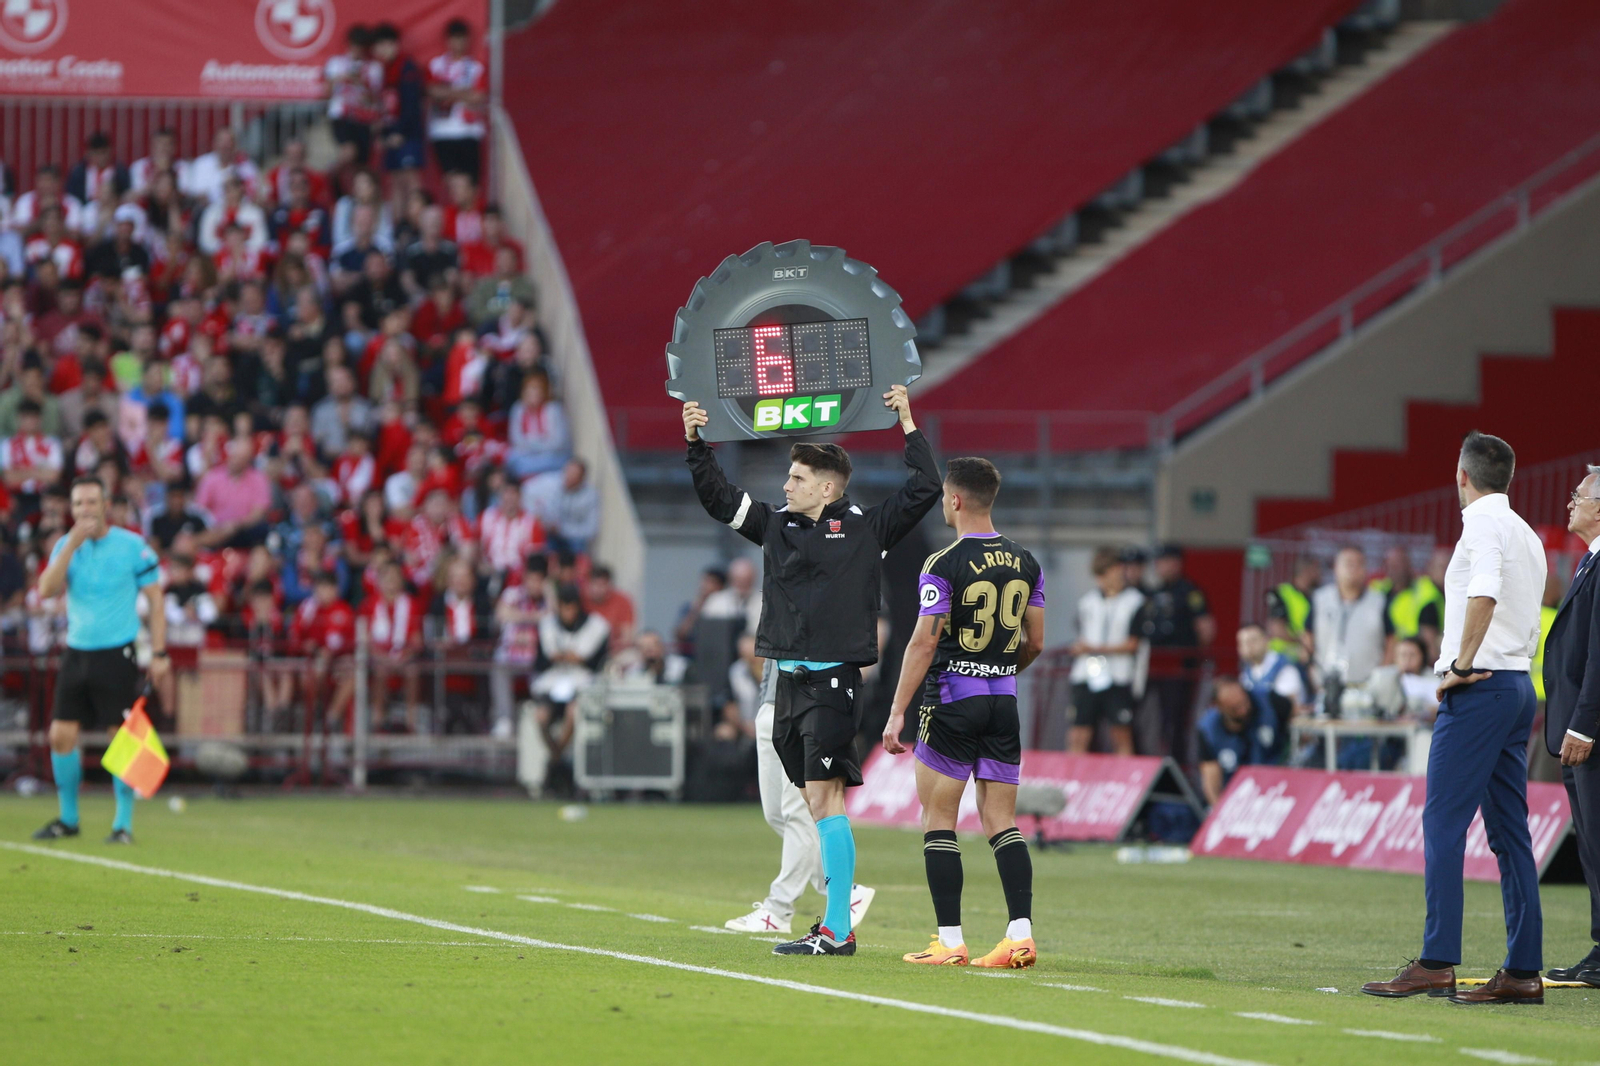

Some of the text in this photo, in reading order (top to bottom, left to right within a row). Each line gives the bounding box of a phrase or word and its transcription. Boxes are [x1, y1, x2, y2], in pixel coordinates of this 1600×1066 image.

[774, 268, 807, 278] BKT
[755, 328, 794, 395] 6
[757, 401, 838, 427] BKT
[969, 551, 1021, 575] L.ROSA
[922, 589, 937, 601] JD
[959, 579, 1030, 653] 39
